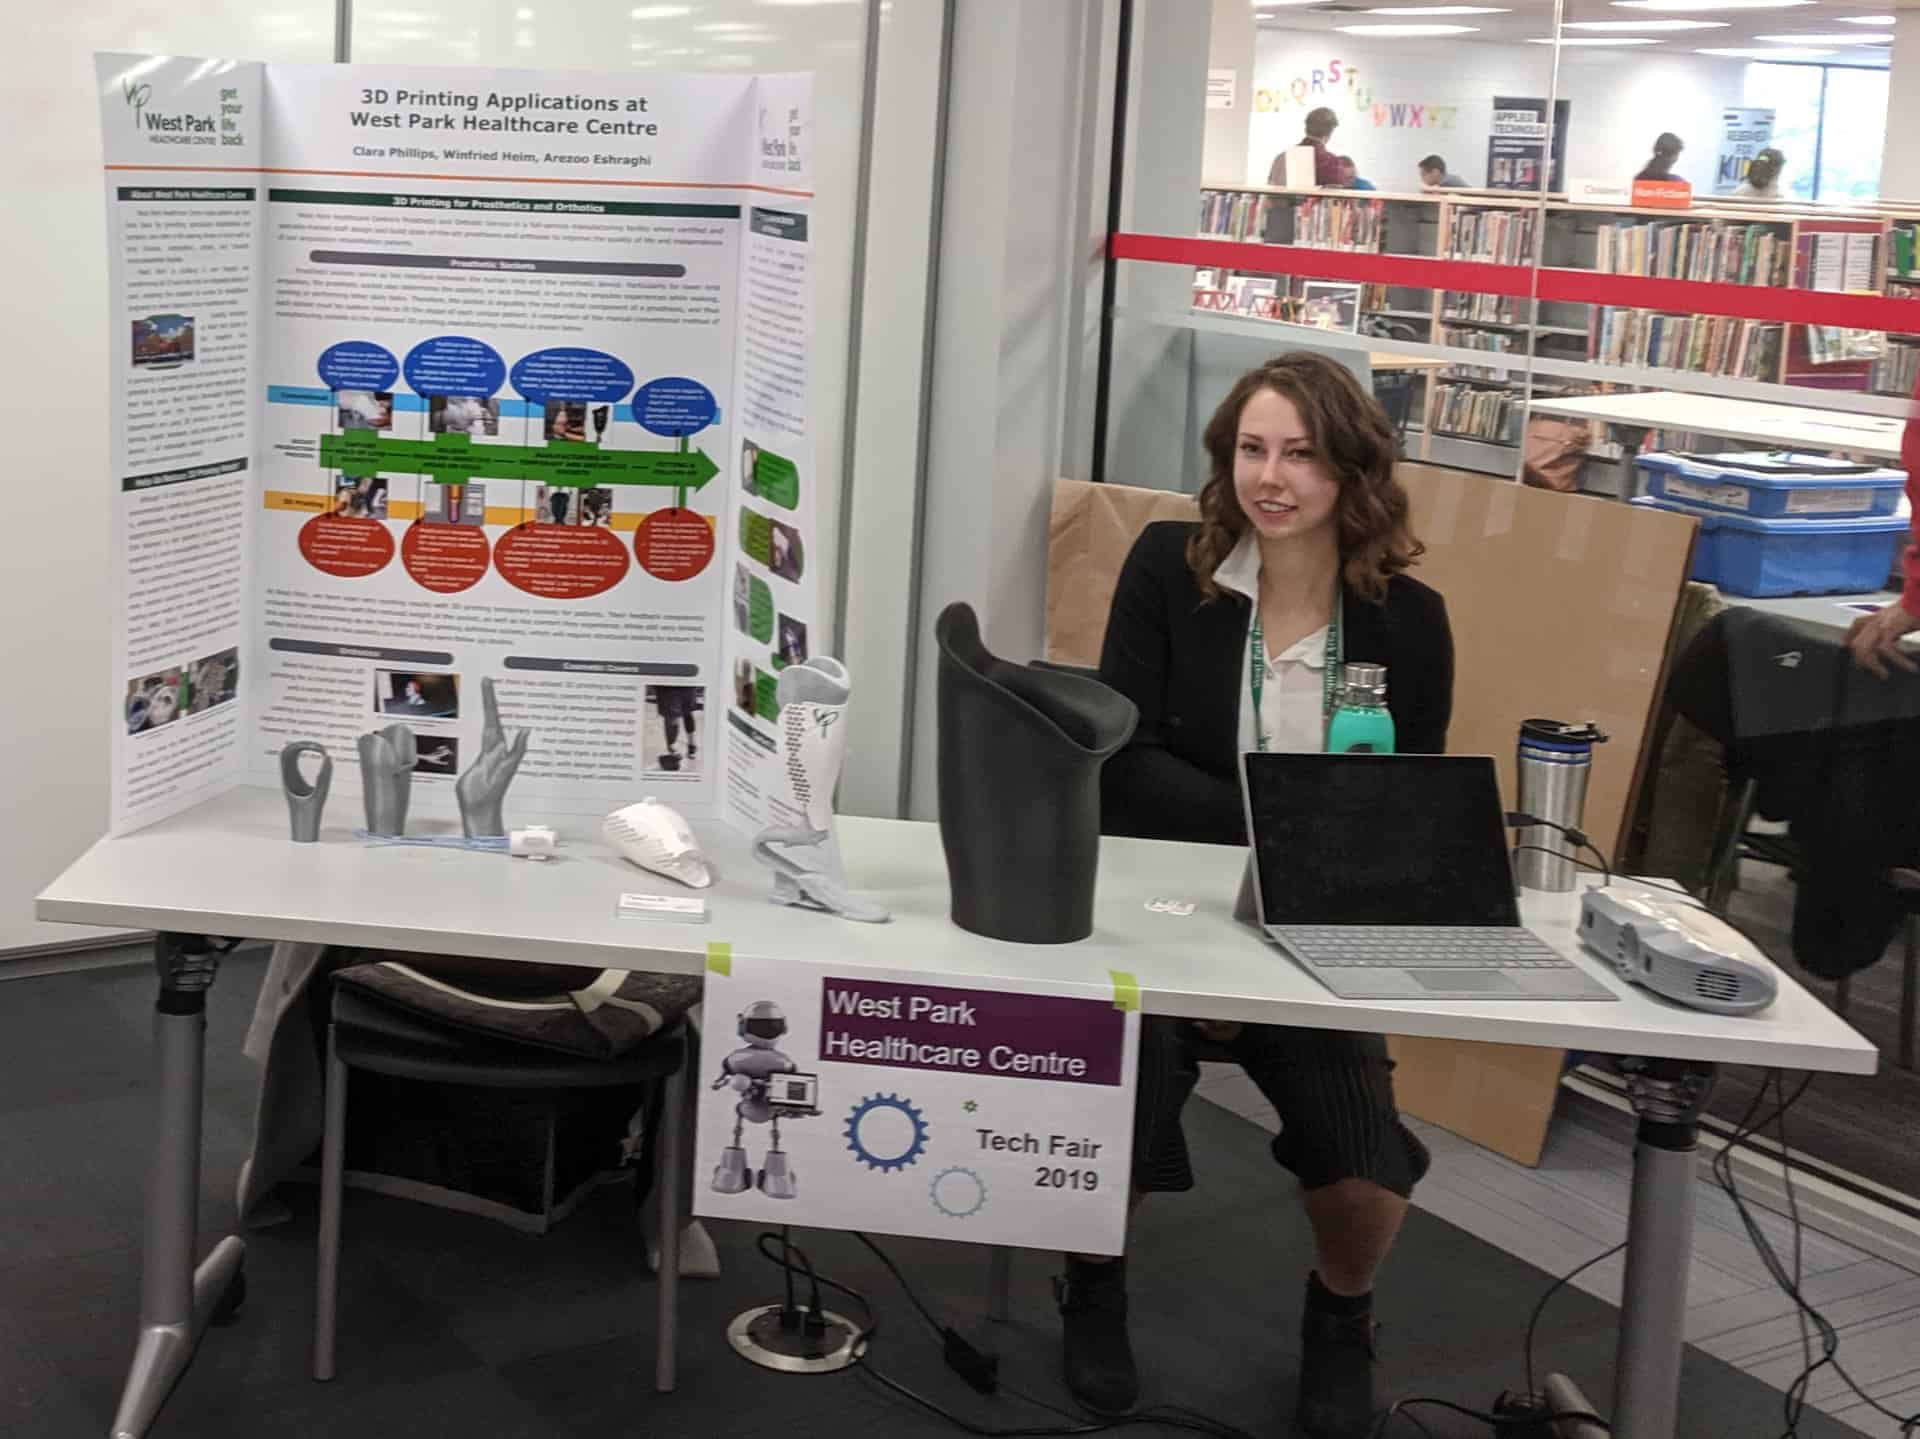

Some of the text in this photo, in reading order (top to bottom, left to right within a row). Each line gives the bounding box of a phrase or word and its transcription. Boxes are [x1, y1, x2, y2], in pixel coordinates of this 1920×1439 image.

[220, 88, 238, 101] get
[361, 89, 648, 113] 3D Printing Applications at
[221, 103, 242, 116] your
[145, 113, 216, 133] West Park
[350, 112, 658, 136] West Park Healthcare Centre
[221, 134, 243, 145] back
[353, 146, 651, 168] Clara Phillips, Winfried Heim, Arezoo Eshraghi
[392, 196, 605, 213] 3D Printing for Prosthetics and Orthotics
[827, 989, 976, 1026] West Park
[825, 1031, 1087, 1077] Healthcare Centre
[976, 1128, 1102, 1160] Tech Fair
[1034, 1166, 1098, 1191] 2019
